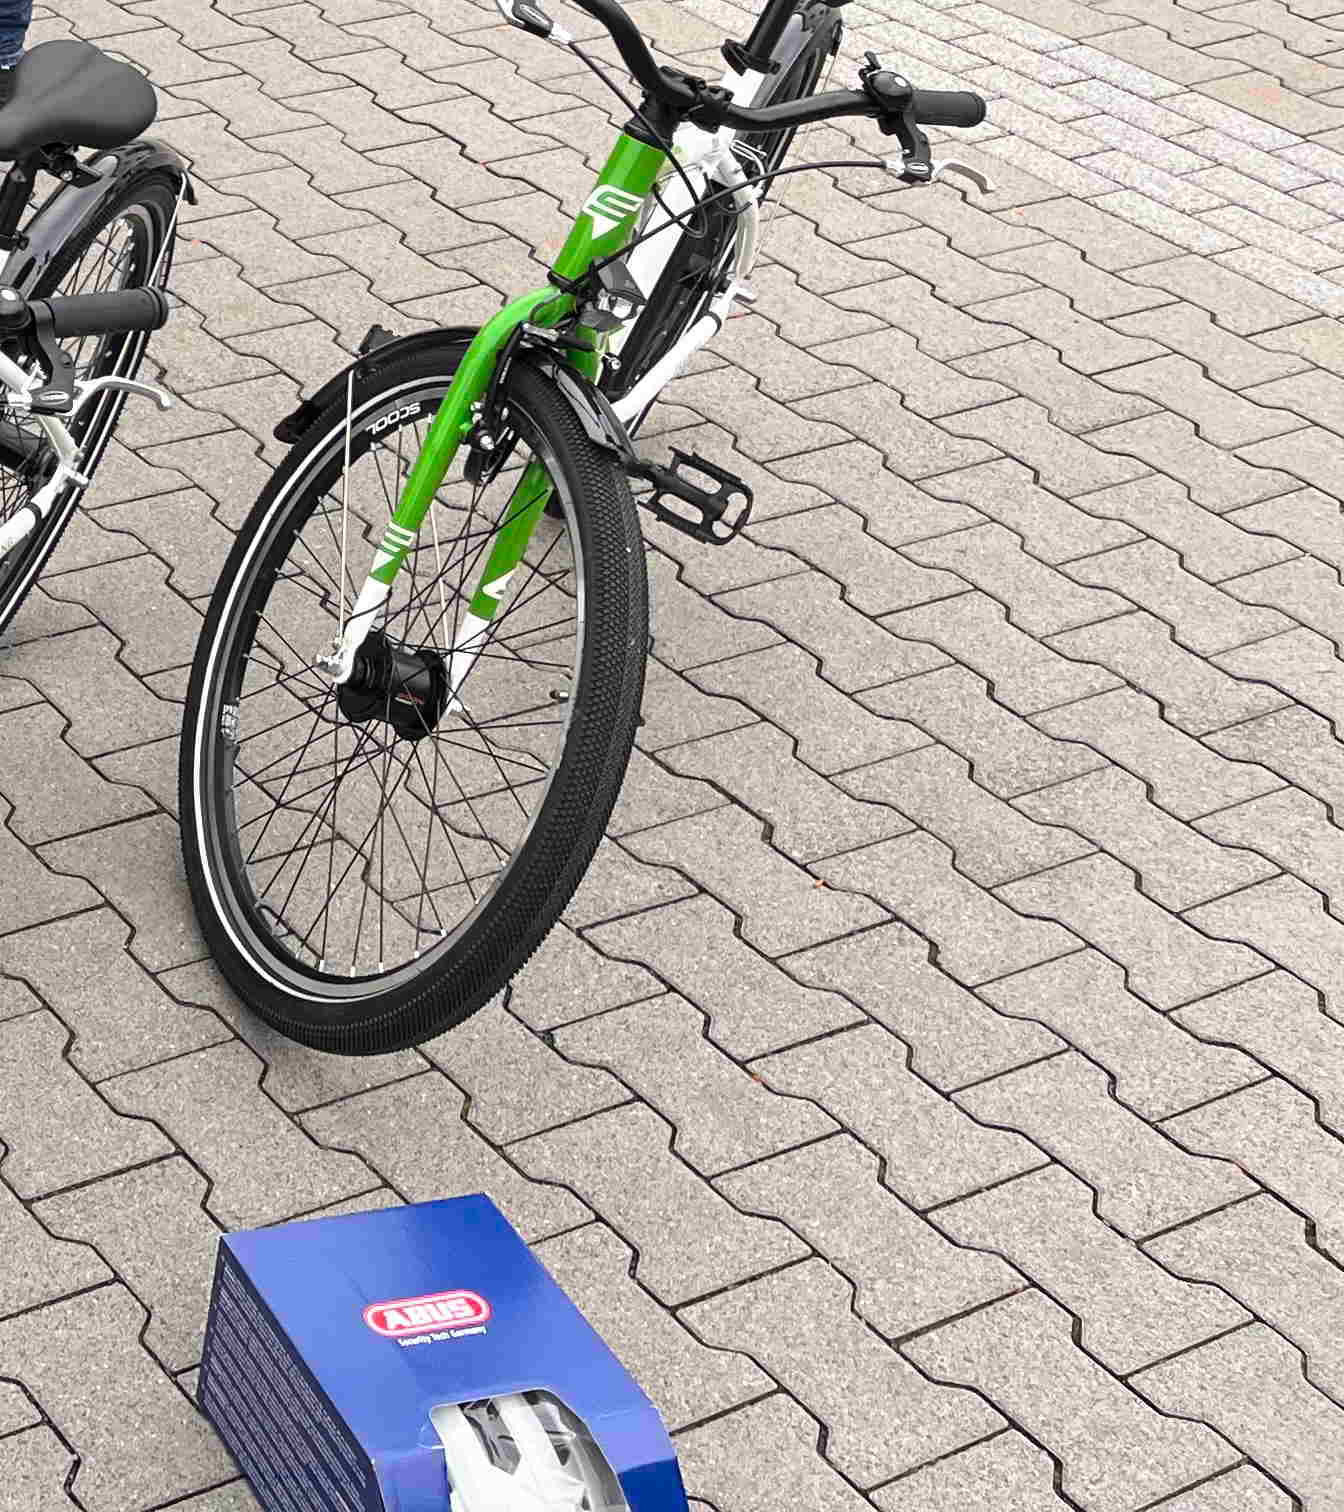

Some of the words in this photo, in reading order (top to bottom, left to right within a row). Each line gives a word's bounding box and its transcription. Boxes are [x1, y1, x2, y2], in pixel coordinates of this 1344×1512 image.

[365, 401, 421, 436] SCOOL
[383, 1298, 474, 1331] ABUS
[397, 1334, 432, 1348] Security
